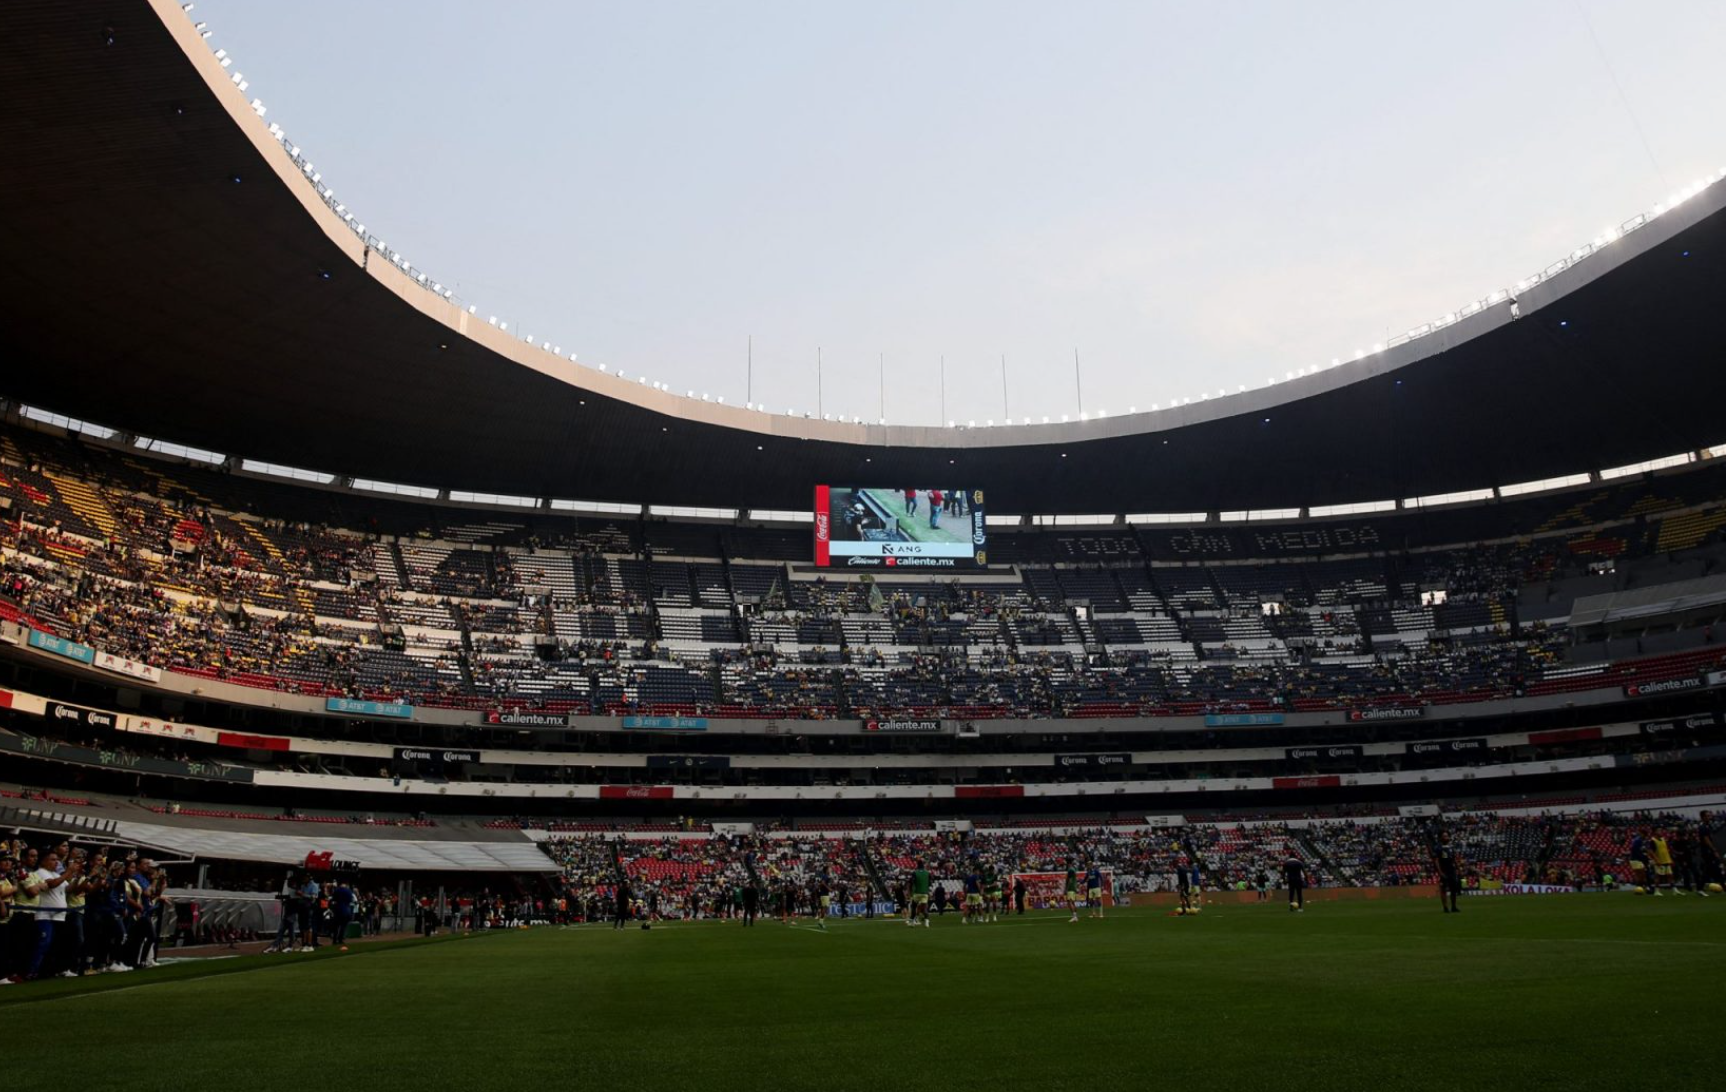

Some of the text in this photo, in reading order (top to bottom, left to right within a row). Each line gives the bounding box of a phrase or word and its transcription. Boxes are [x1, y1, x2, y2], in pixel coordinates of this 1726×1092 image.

[974, 511, 986, 545] Corona
[1057, 537, 1141, 554] TODO
[1255, 526, 1379, 550] MEDIDA
[898, 545, 922, 553] ANG
[896, 557, 955, 567] caliente.mx
[1638, 678, 1701, 694] caliente.mx
[54, 705, 111, 726] Corona Corona
[500, 713, 564, 726] caliente.mx
[1361, 707, 1421, 719] caliente.mx
[878, 720, 937, 731] caliente.mx
[1646, 721, 1674, 734] Corona
[1291, 747, 1354, 758] Corona Corona
[1413, 740, 1479, 753] Corona Corona
[402, 749, 471, 762] Corona Corona
[1061, 755, 1124, 765] Corona Corona
